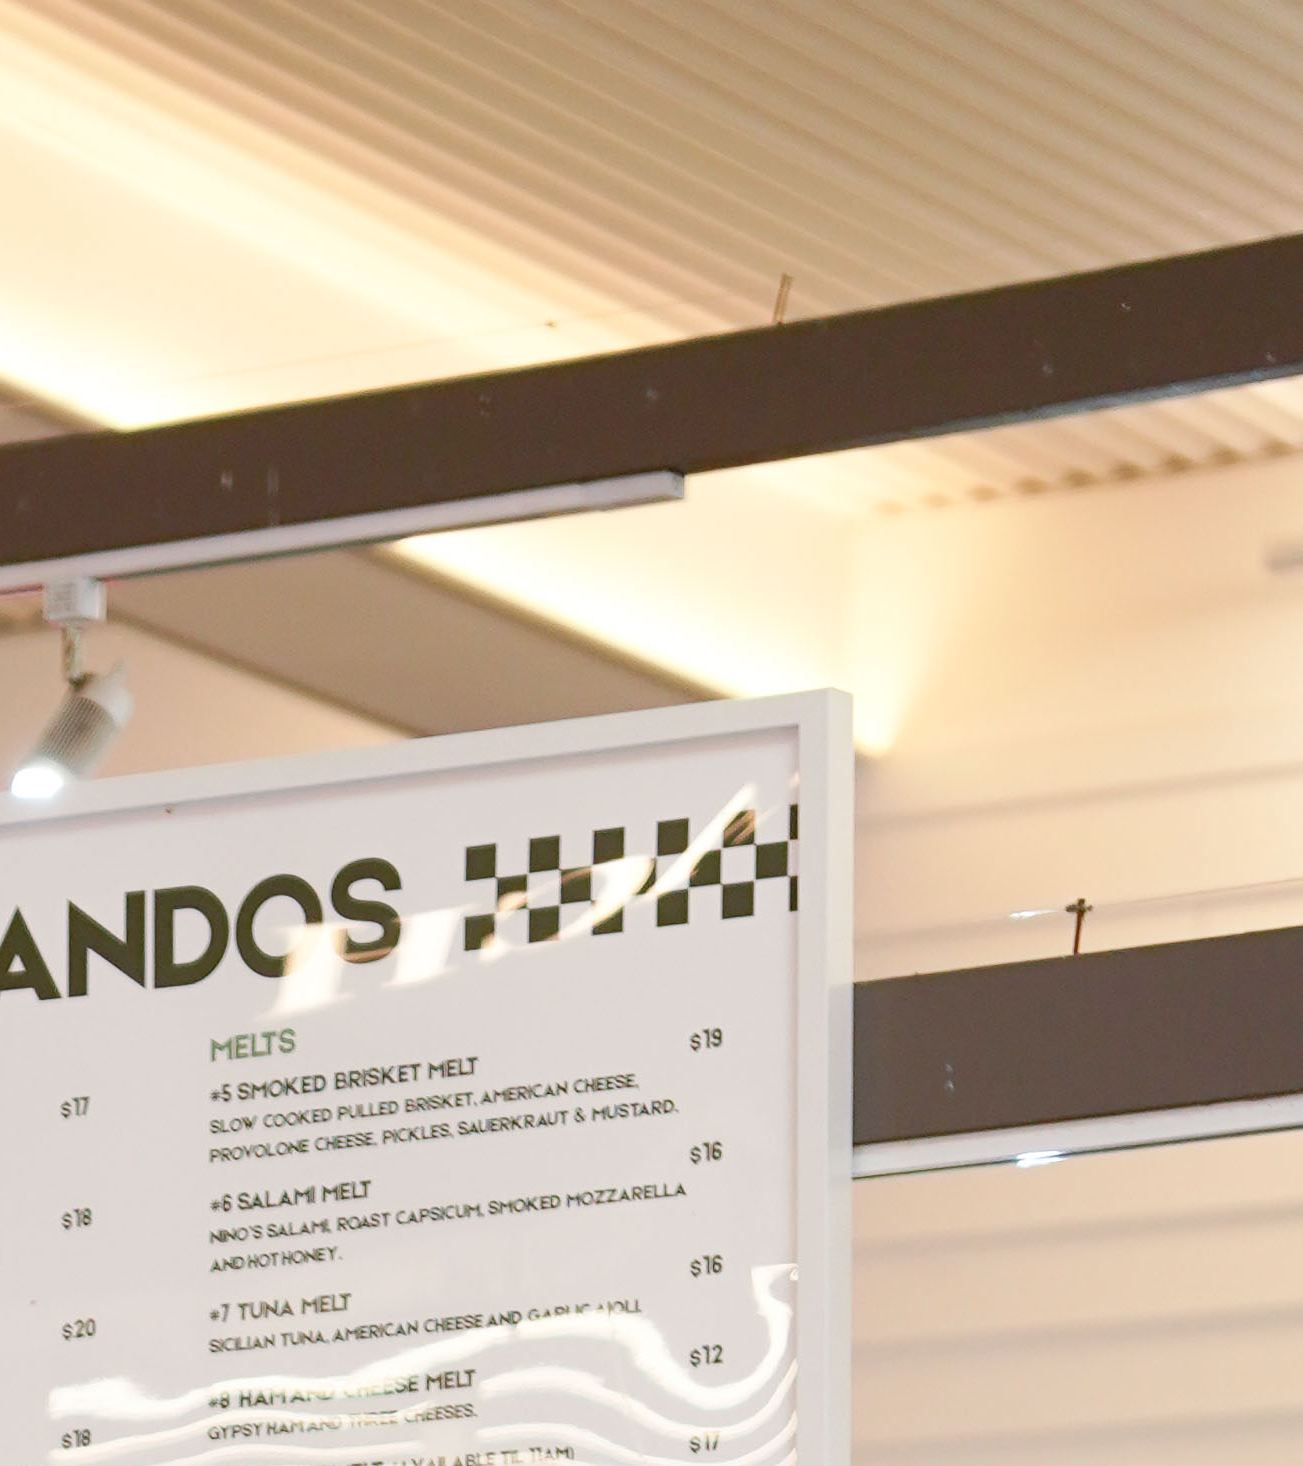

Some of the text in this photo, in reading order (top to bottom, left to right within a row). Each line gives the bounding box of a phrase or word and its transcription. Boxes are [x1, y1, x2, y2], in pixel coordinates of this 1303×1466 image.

[209, 1027, 296, 1062] MELTS
[688, 1026, 723, 1052] $19
[235, 1073, 327, 1101] SMOKED
[333, 1061, 422, 1091] BRISKET
[426, 1055, 479, 1080] MELT
[59, 1094, 90, 1120] $17
[688, 1139, 723, 1165] $16
[235, 1185, 316, 1211] SALAMI
[320, 1178, 372, 1203] MELT
[236, 1298, 295, 1321] TUNA
[299, 1291, 352, 1315] MELT
[61, 1316, 97, 1341] $20
[688, 1342, 724, 1368] $12
